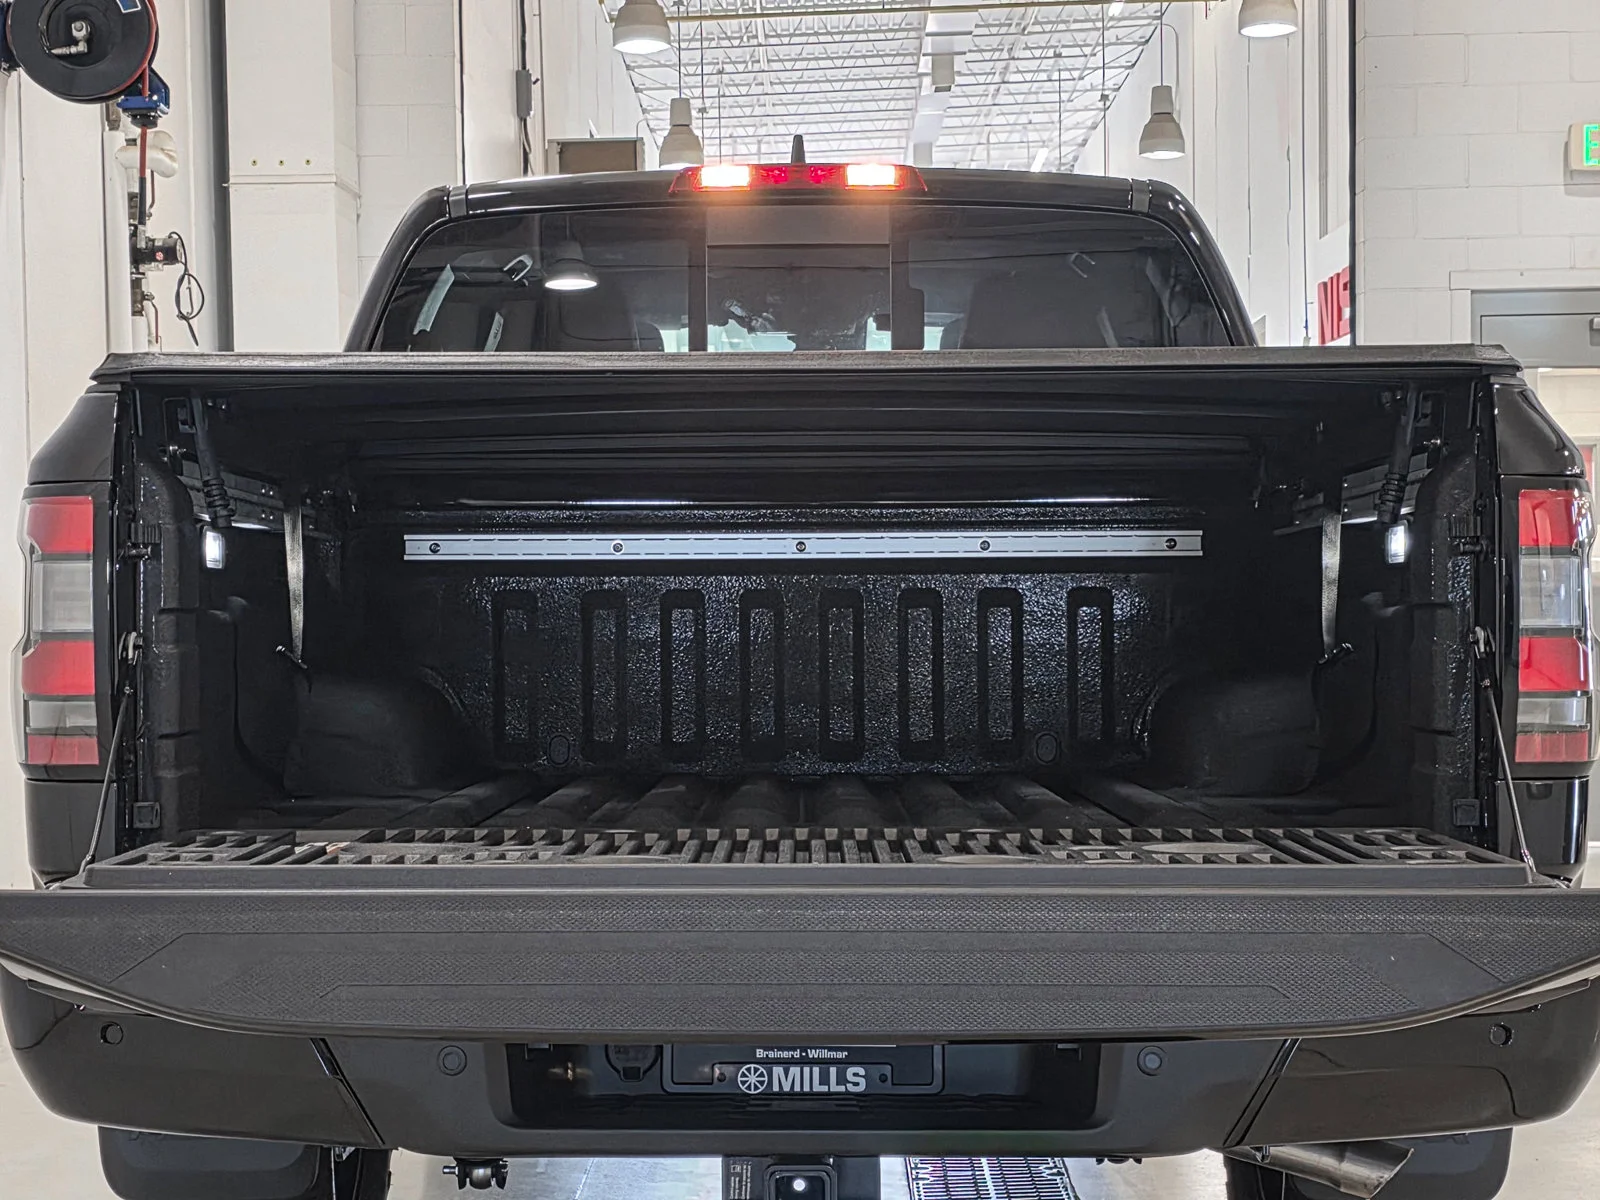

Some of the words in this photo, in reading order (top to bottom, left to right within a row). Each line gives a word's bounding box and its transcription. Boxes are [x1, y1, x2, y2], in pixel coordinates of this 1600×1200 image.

[756, 1048, 800, 1059] Brainerd
[807, 1048, 848, 1059] Willmar
[772, 1066, 867, 1093] MILLS
